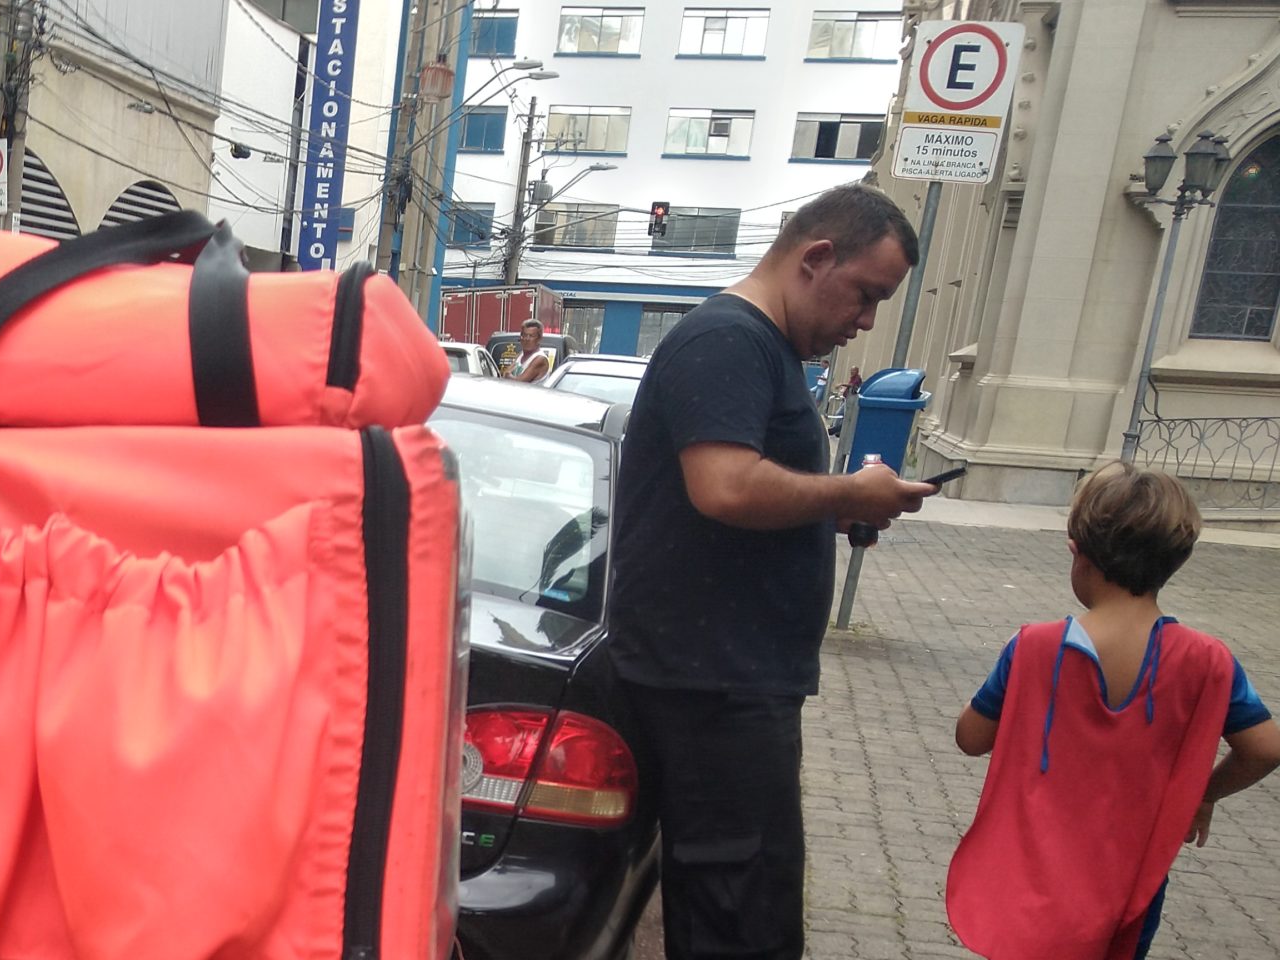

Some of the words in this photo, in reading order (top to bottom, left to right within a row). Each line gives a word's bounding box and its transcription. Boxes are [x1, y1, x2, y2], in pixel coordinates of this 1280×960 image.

[946, 44, 981, 90] E
[917, 114, 946, 125] VAGA
[924, 131, 974, 146] MÁXIMO
[915, 145, 929, 155] 15
[931, 146, 978, 158] minutos
[946, 161, 976, 169] BRANCA
[954, 170, 982, 179] LIGADO
